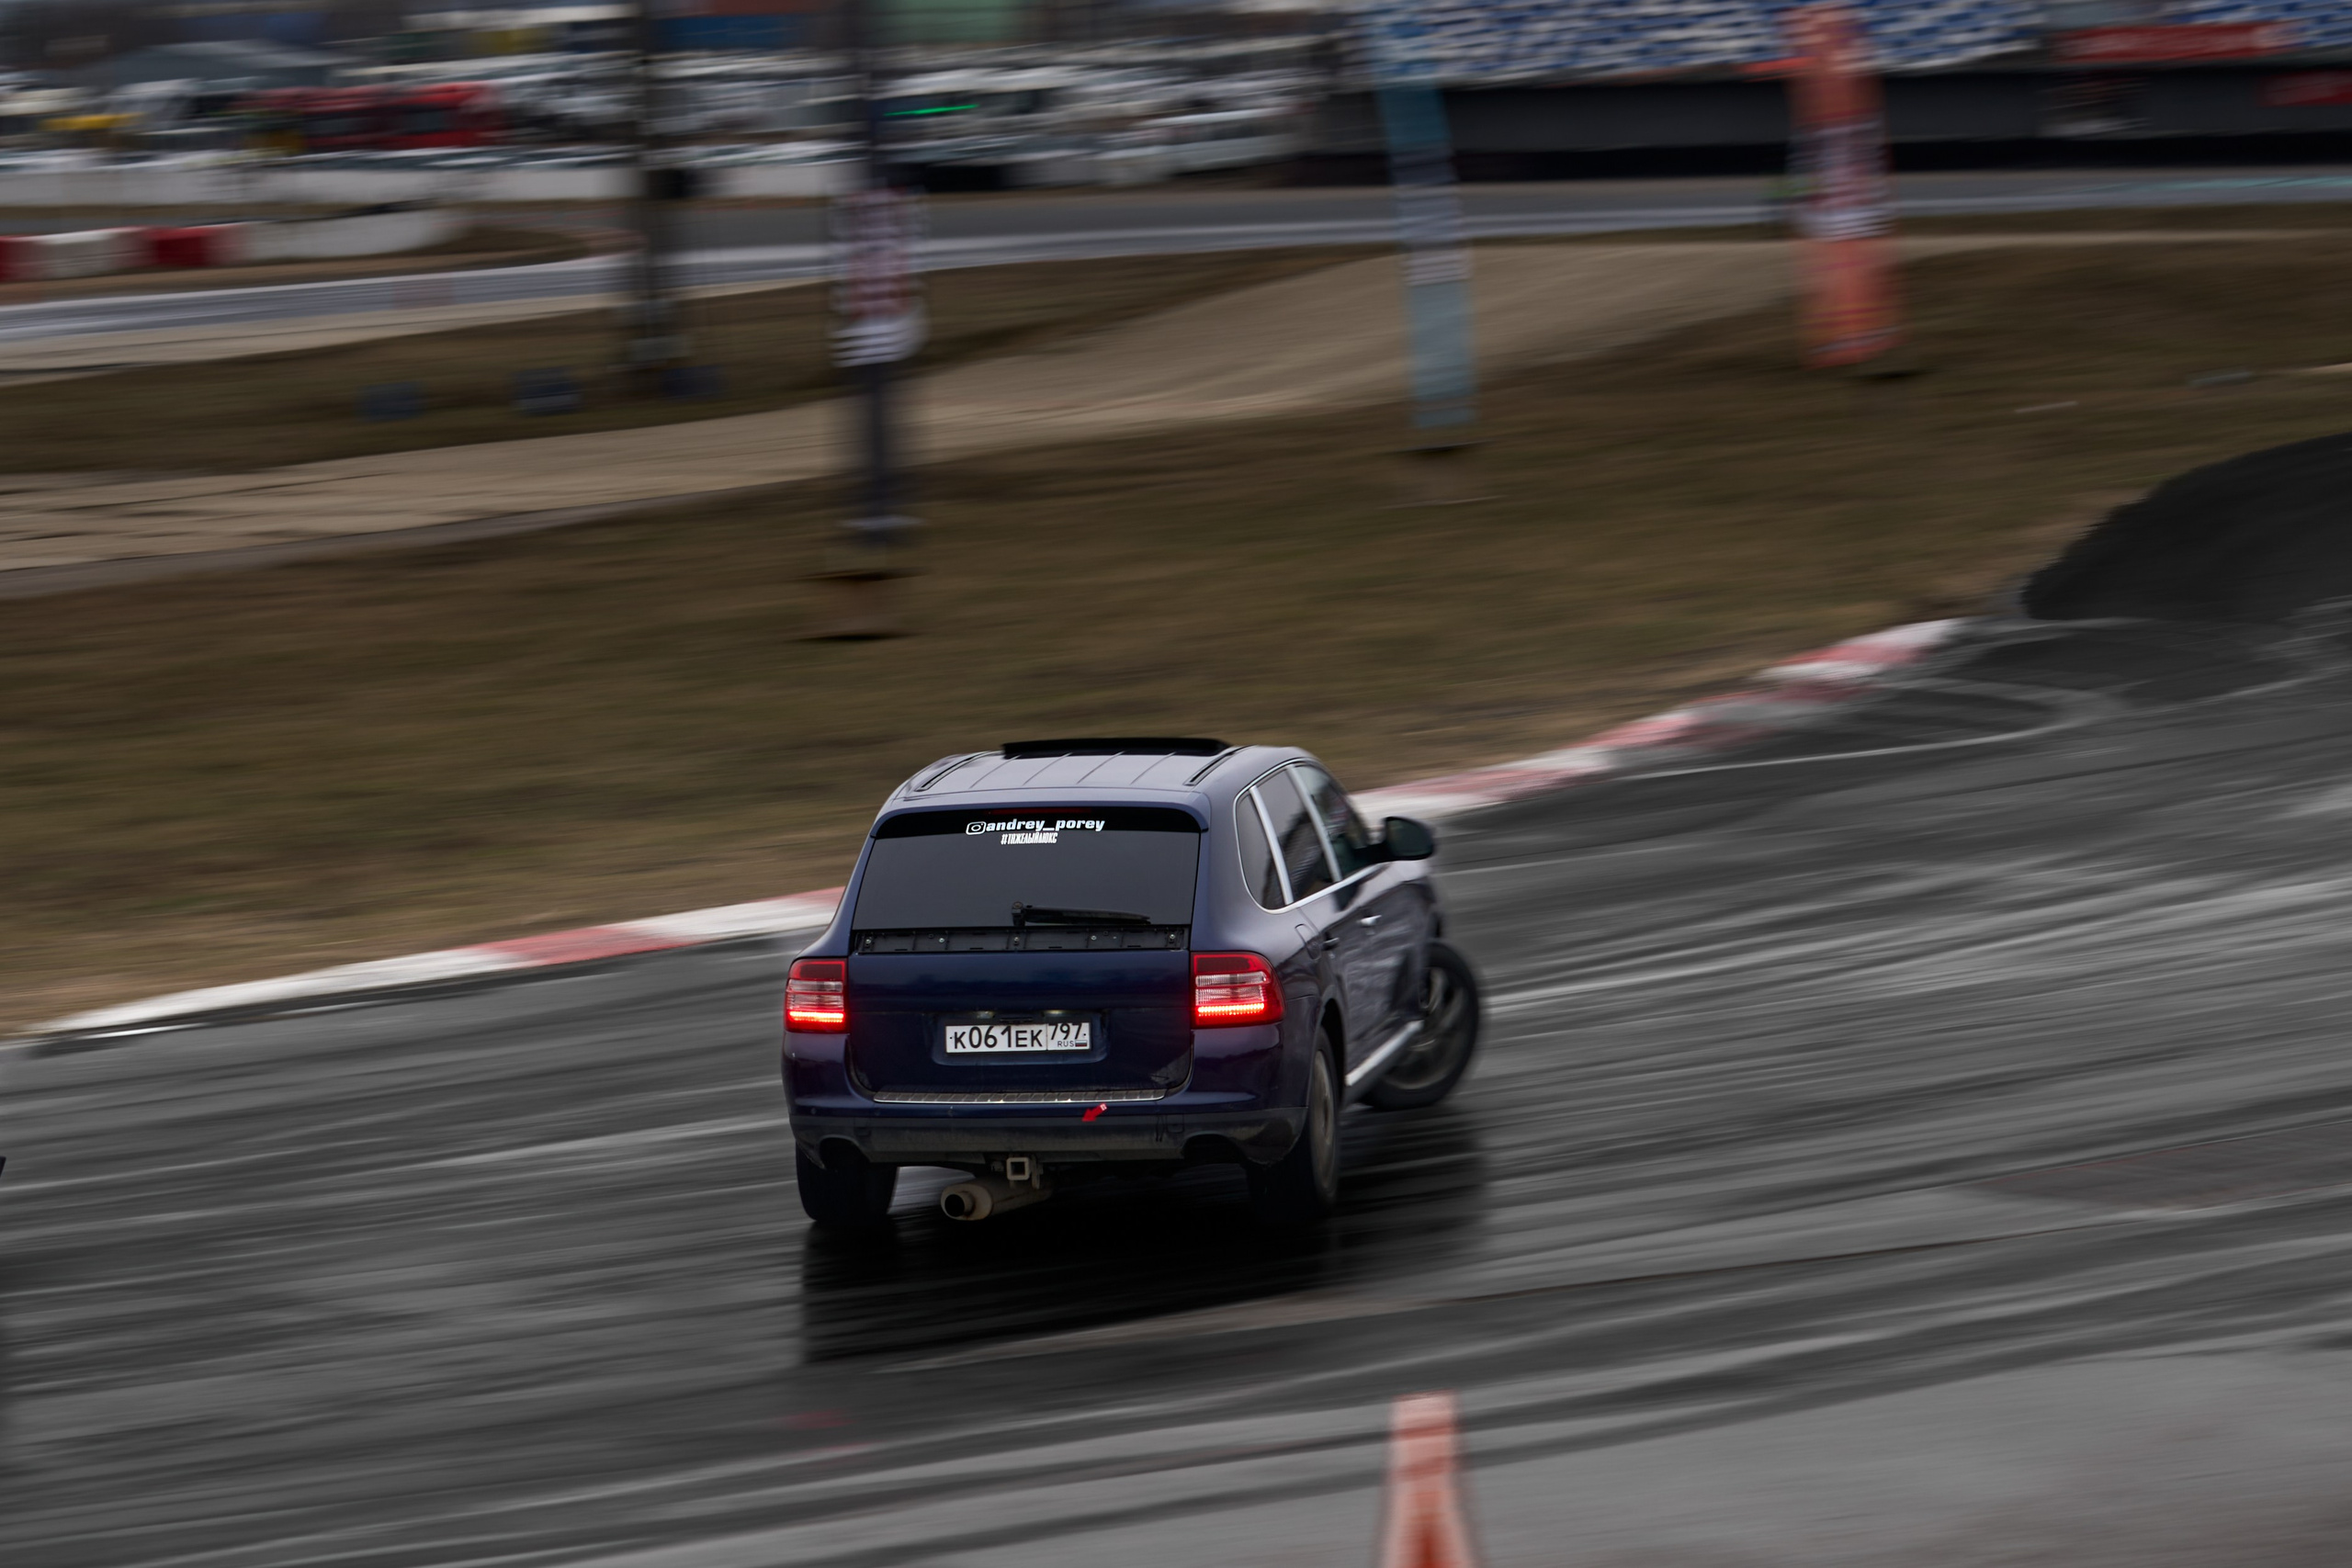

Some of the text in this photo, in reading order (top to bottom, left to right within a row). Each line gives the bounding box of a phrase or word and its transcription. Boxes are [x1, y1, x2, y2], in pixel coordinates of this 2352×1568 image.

[986, 818, 1105, 832] andrey_porey
[1048, 1022, 1082, 1040] 797
[1057, 1040, 1075, 1048] RUS
